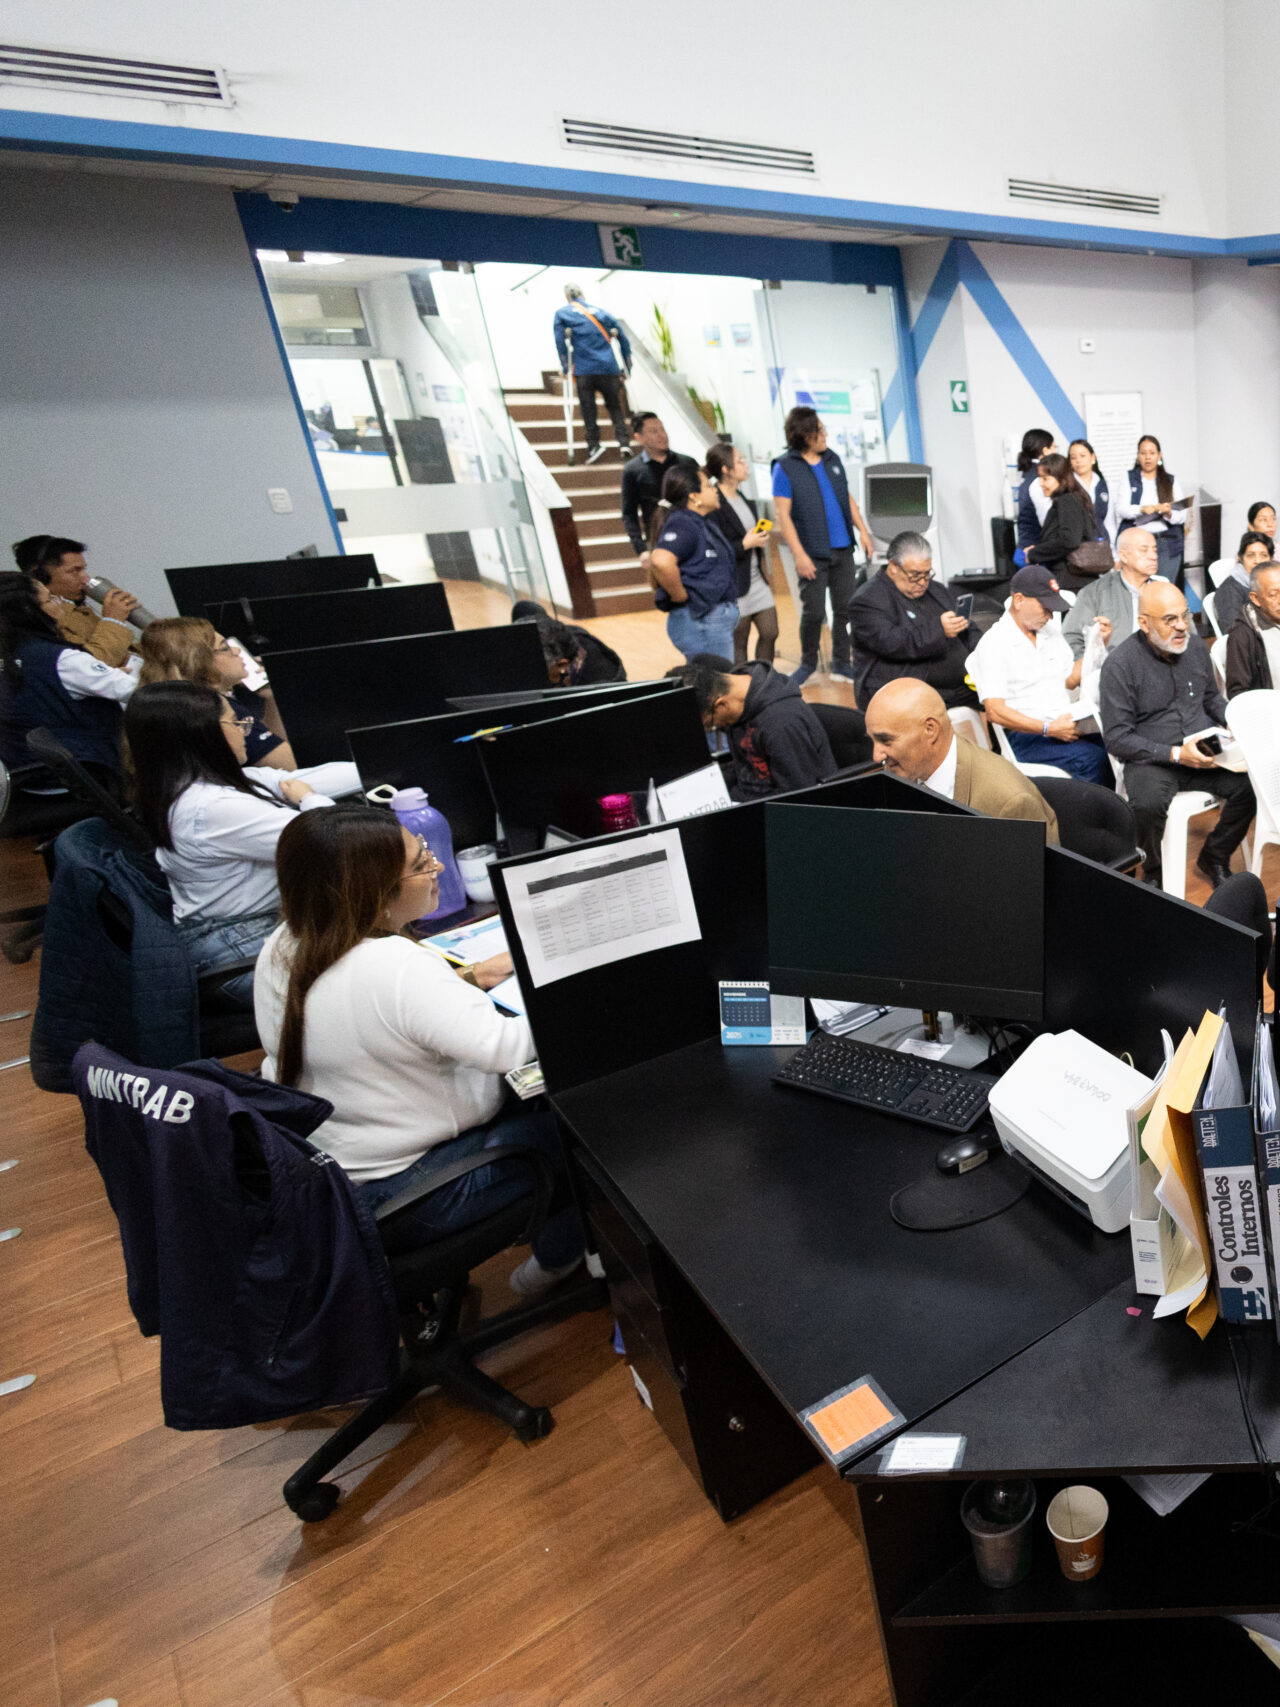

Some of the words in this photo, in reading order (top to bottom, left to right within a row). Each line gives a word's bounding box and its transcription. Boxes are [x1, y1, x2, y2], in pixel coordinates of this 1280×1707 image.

[87, 1065, 195, 1124] MINTRAB
[1211, 1175, 1238, 1263] Controles
[1238, 1179, 1260, 1257] Internos
